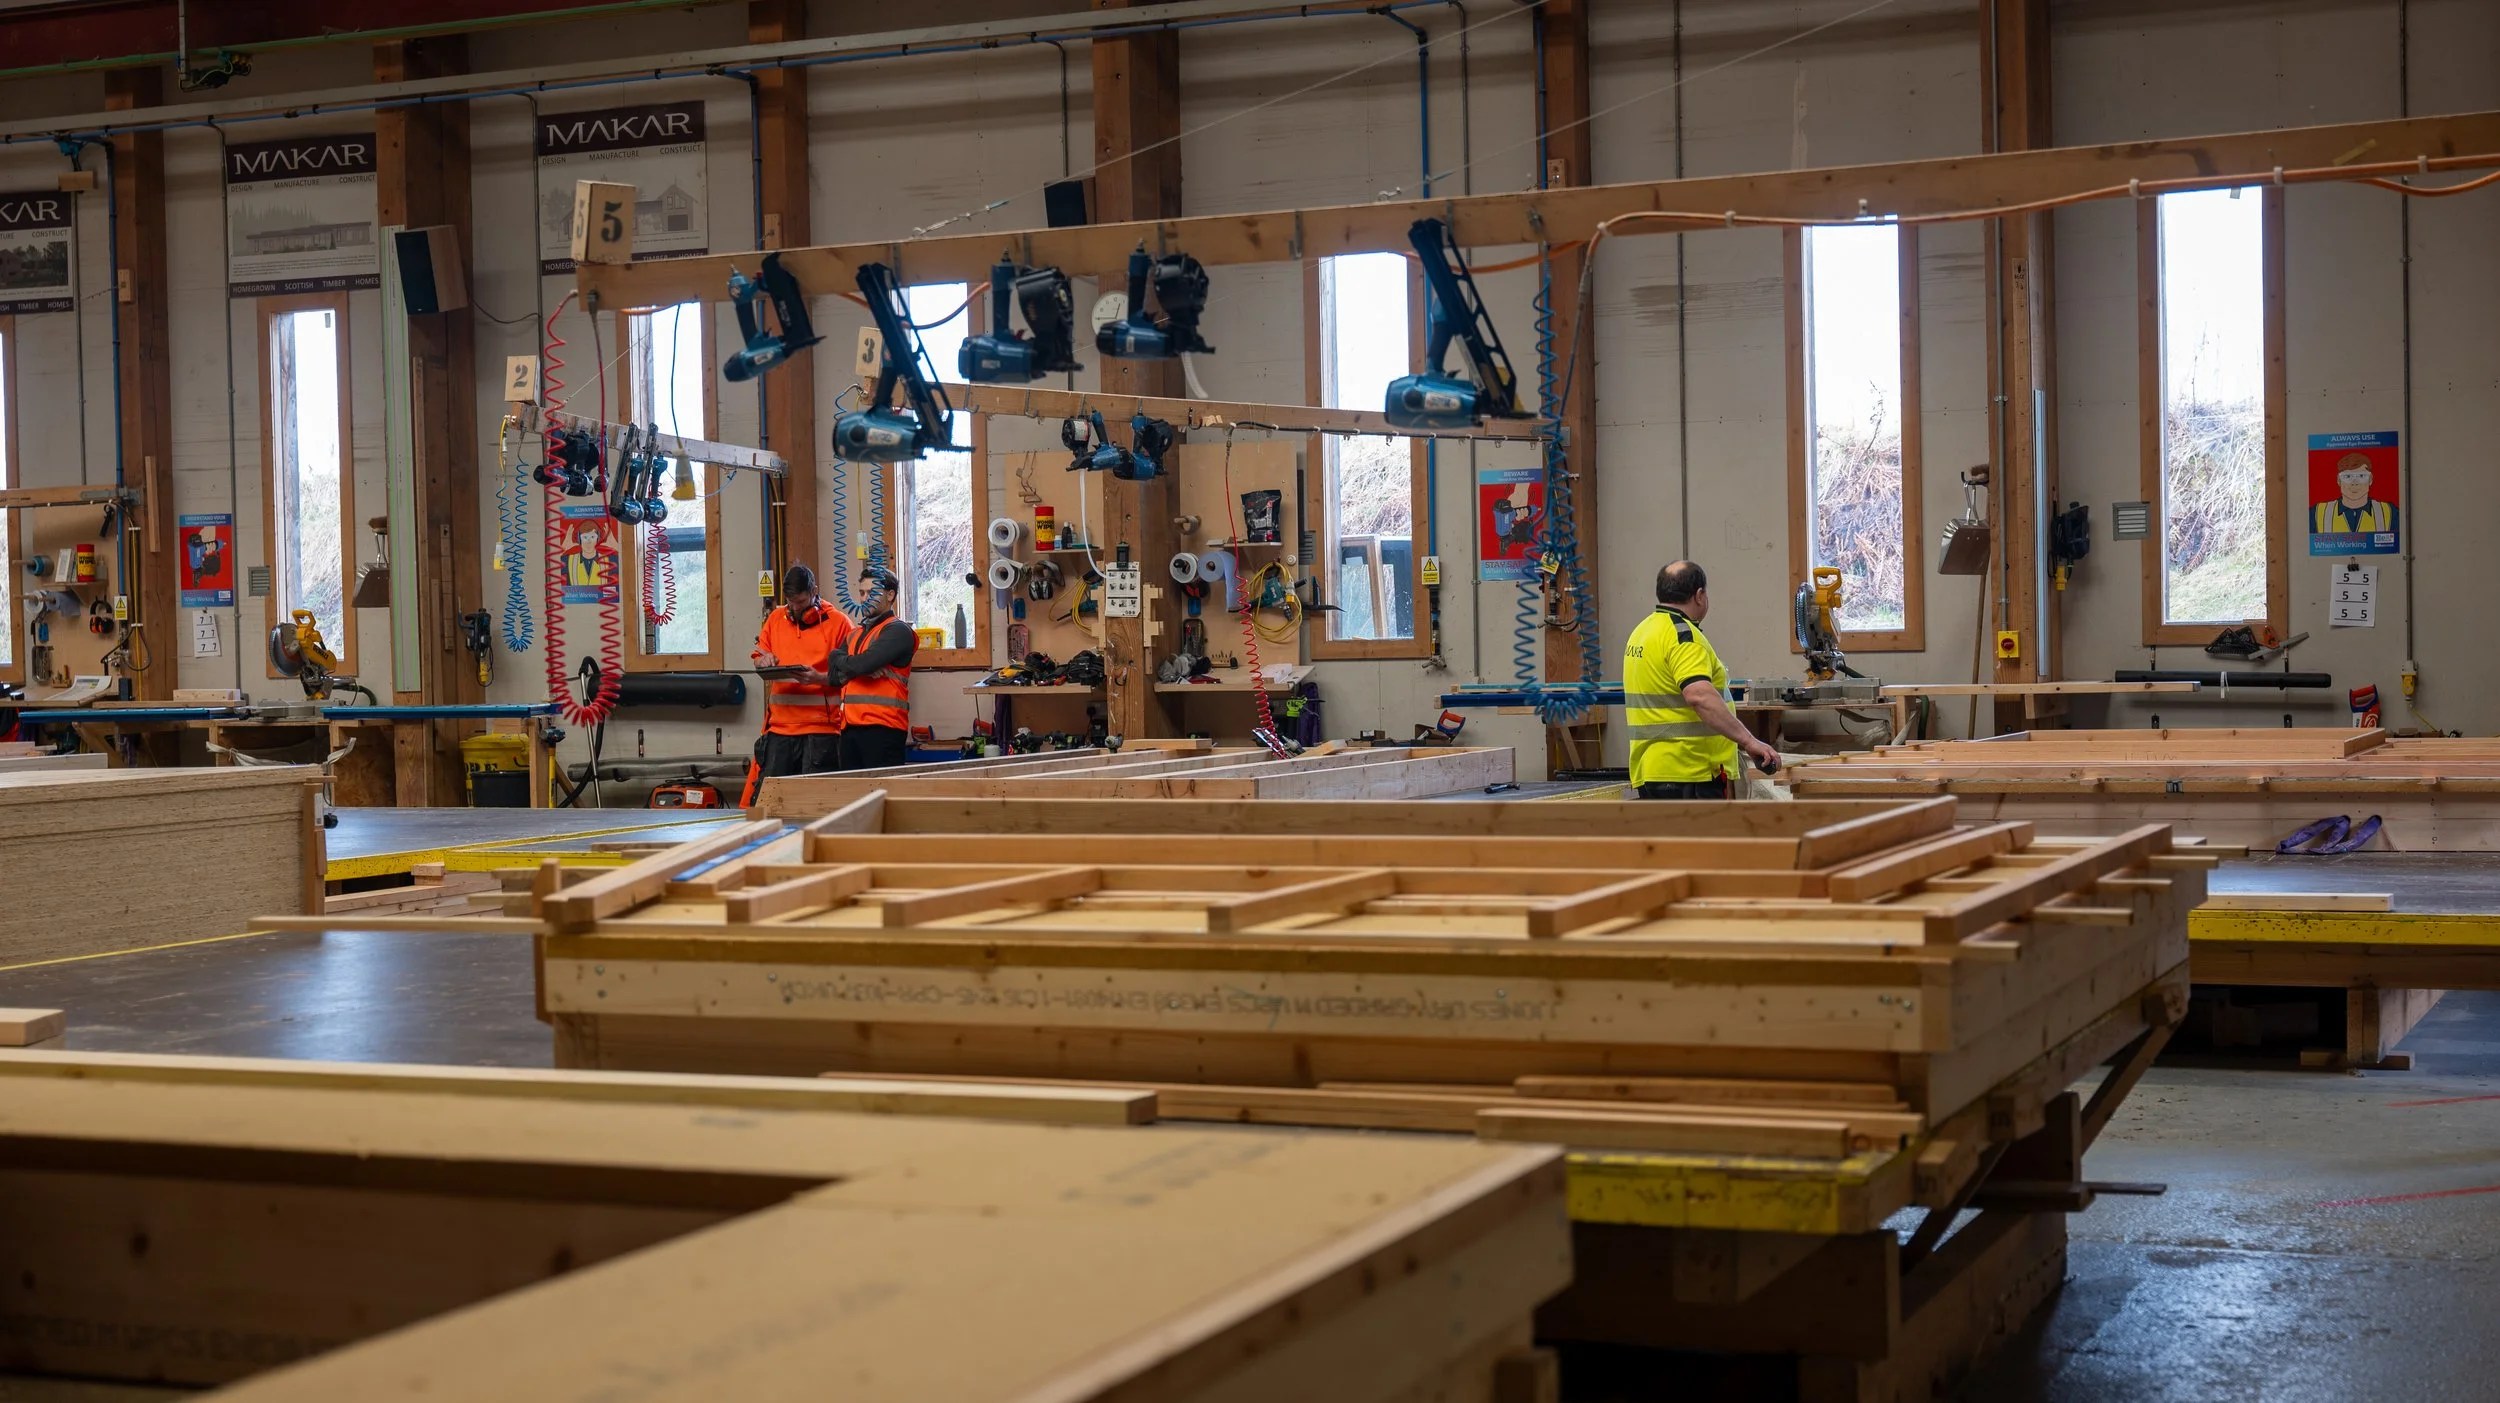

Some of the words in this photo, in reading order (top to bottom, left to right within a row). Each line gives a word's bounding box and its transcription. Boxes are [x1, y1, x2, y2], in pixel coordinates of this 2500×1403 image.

[546, 112, 693, 147] MAKAR
[233, 143, 369, 175] MAKAR
[542, 156, 567, 165] DESIGN
[589, 150, 640, 161] MANUFACTURE
[660, 144, 700, 155] CONSTRUCT
[231, 184, 253, 193] DESIGN
[274, 178, 320, 189] MANUFACTURE
[339, 175, 376, 184] CONSTRUCT
[601, 201, 623, 242] 5
[31, 229, 69, 239] CONSTRUCT
[232, 284, 276, 294] HOMEGROWN
[284, 281, 314, 291] SCOTTISH
[322, 279, 346, 288] TIMBER
[355, 277, 379, 286] HOMES
[862, 337, 875, 364] 3
[513, 364, 528, 389] 2
[2343, 573, 2350, 582] 5
[2362, 573, 2369, 583] 5
[2342, 591, 2349, 600] 5
[2361, 592, 2369, 601] 5
[200, 616, 204, 624] 7
[2341, 608, 2348, 618] 5
[2360, 609, 2368, 619] 5
[201, 630, 205, 638] 7
[201, 643, 206, 651] 7
[212, 642, 217, 650] 7
